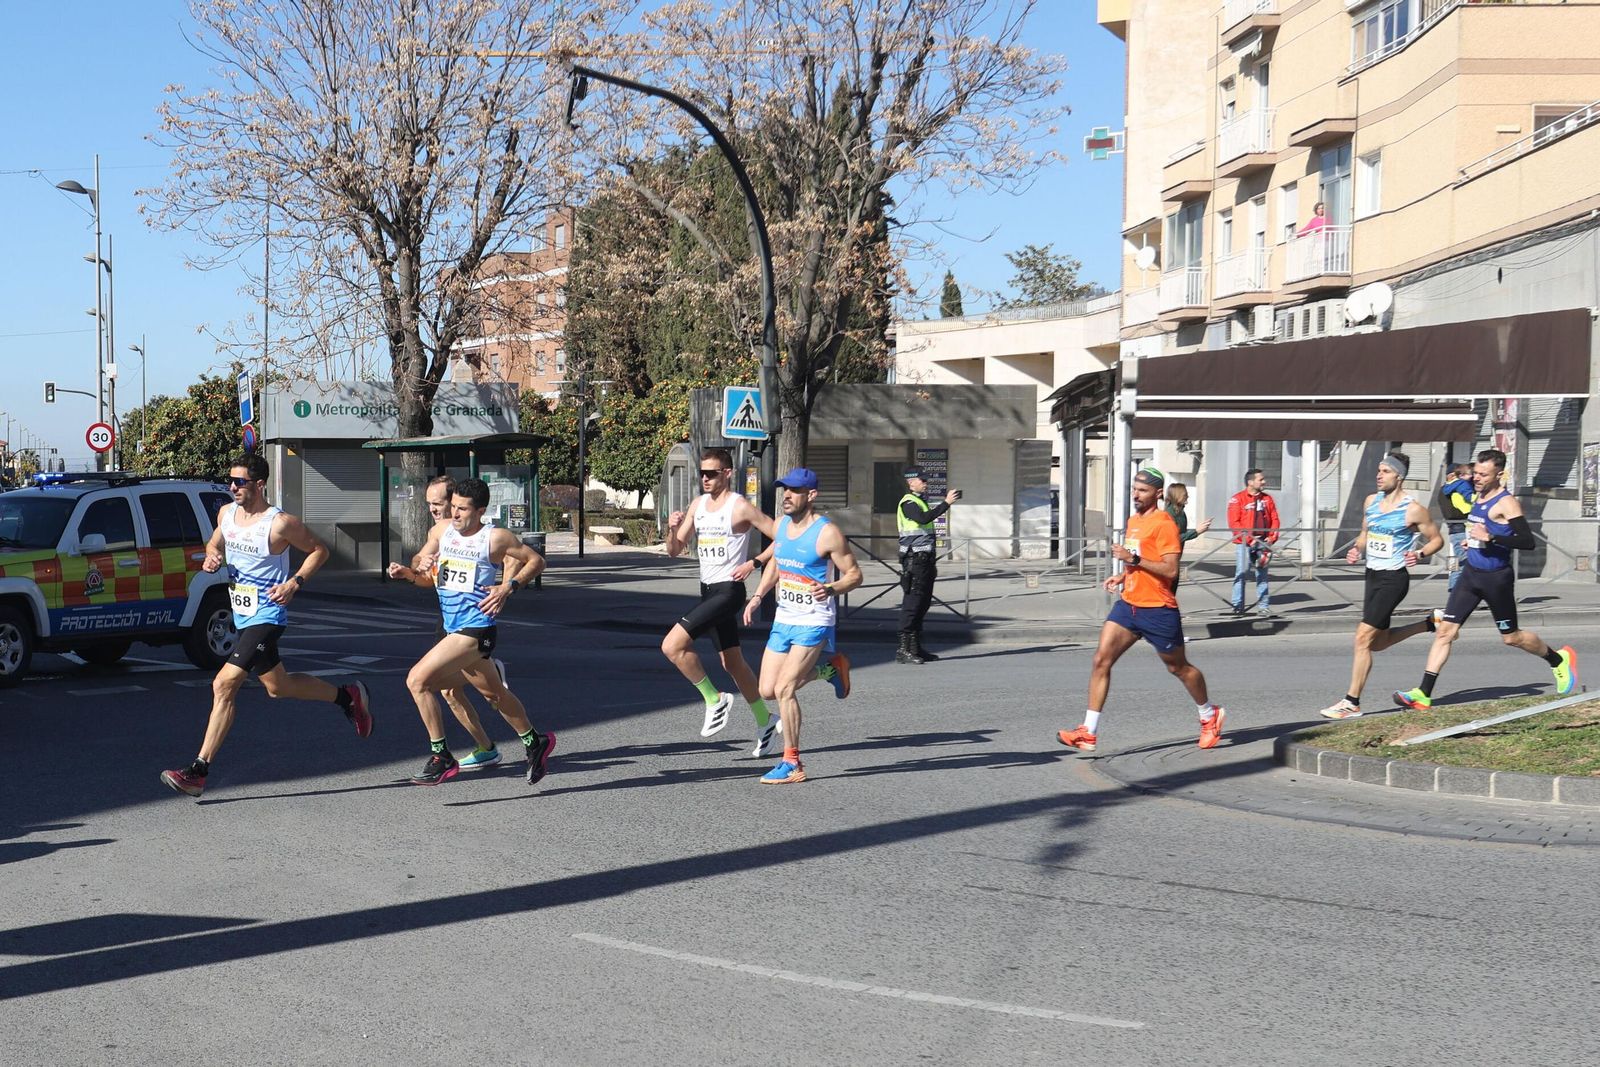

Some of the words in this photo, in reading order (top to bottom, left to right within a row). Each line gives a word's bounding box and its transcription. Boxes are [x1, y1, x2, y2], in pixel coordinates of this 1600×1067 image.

[446, 403, 503, 417] Granada
[92, 432, 109, 443] 30
[699, 546, 725, 557] 3118
[1368, 541, 1387, 552] 452
[442, 568, 467, 584] 575
[781, 588, 813, 605] 3083
